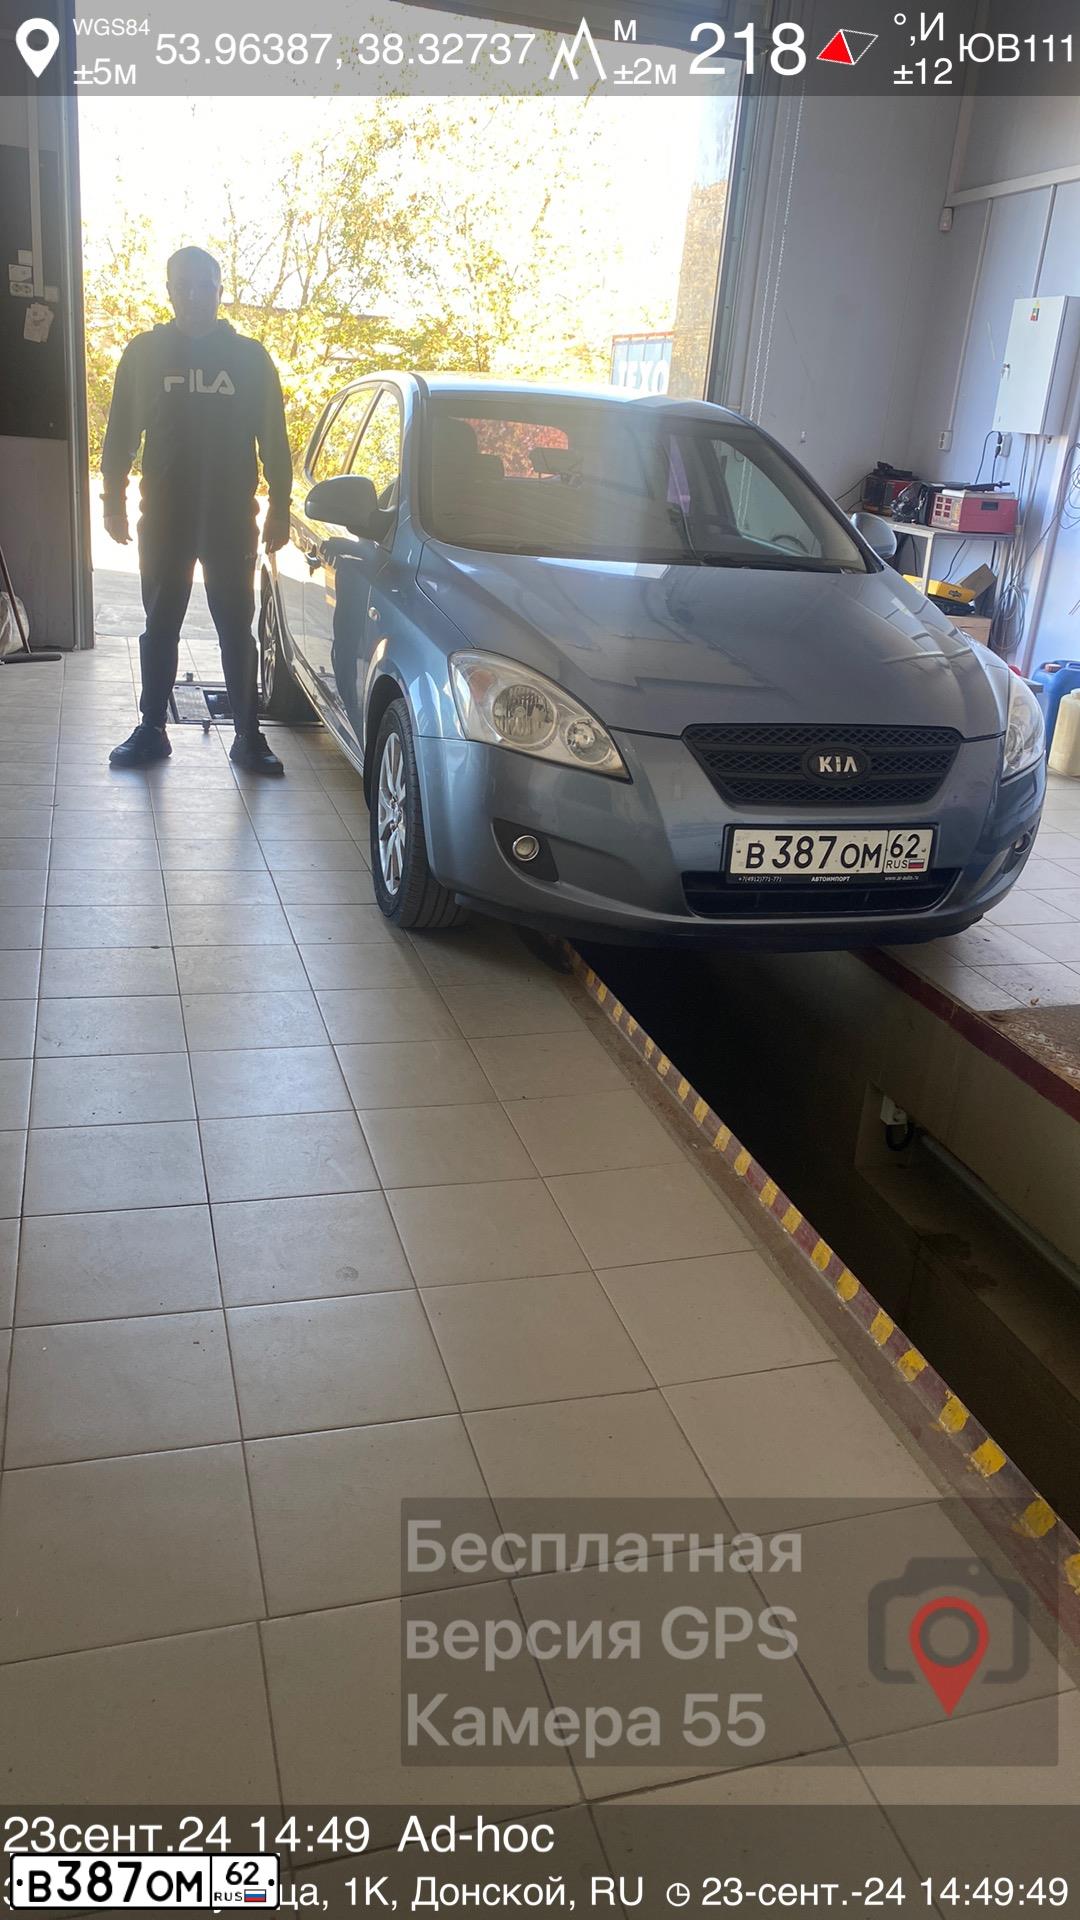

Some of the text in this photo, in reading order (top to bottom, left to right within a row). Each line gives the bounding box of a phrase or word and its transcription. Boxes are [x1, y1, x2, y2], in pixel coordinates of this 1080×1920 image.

[163, 368, 235, 395] FILA
[818, 755, 858, 773] KIA
[889, 834, 921, 859] 62
[885, 859, 908, 869] RUS
